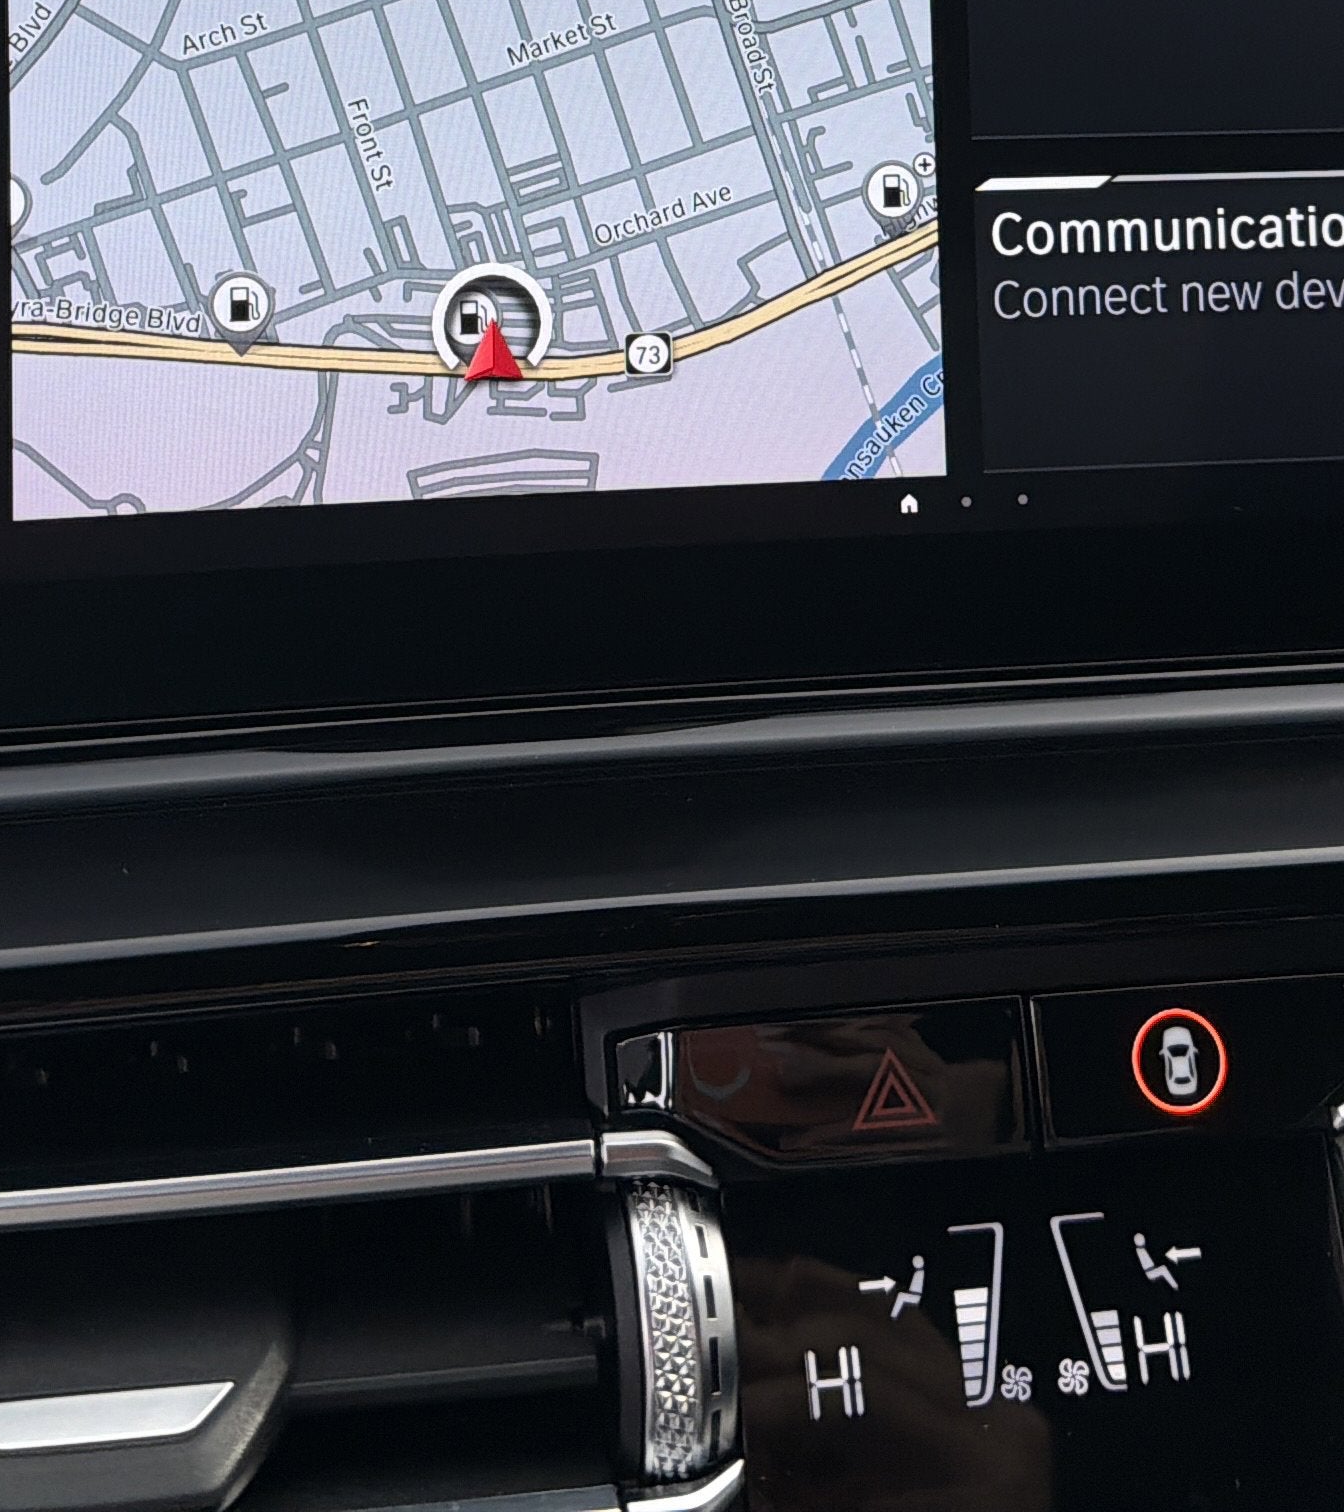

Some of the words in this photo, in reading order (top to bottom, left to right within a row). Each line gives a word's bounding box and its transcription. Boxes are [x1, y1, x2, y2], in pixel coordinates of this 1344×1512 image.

[9, 1, 52, 52] Blvd
[181, 22, 236, 56] Arch
[241, 12, 267, 35] St
[506, 22, 588, 66] Market
[591, 13, 616, 35] St
[753, 67, 774, 94] St
[348, 98, 383, 162] Front
[371, 164, 393, 191] St
[594, 199, 686, 245] Orchard
[692, 186, 733, 213] Ave
[147, 308, 201, 333] Blvd
[993, 274, 1167, 320] Connect
[1181, 277, 1261, 313] new
[635, 345, 661, 365] 73
[843, 395, 925, 480] nsauken
